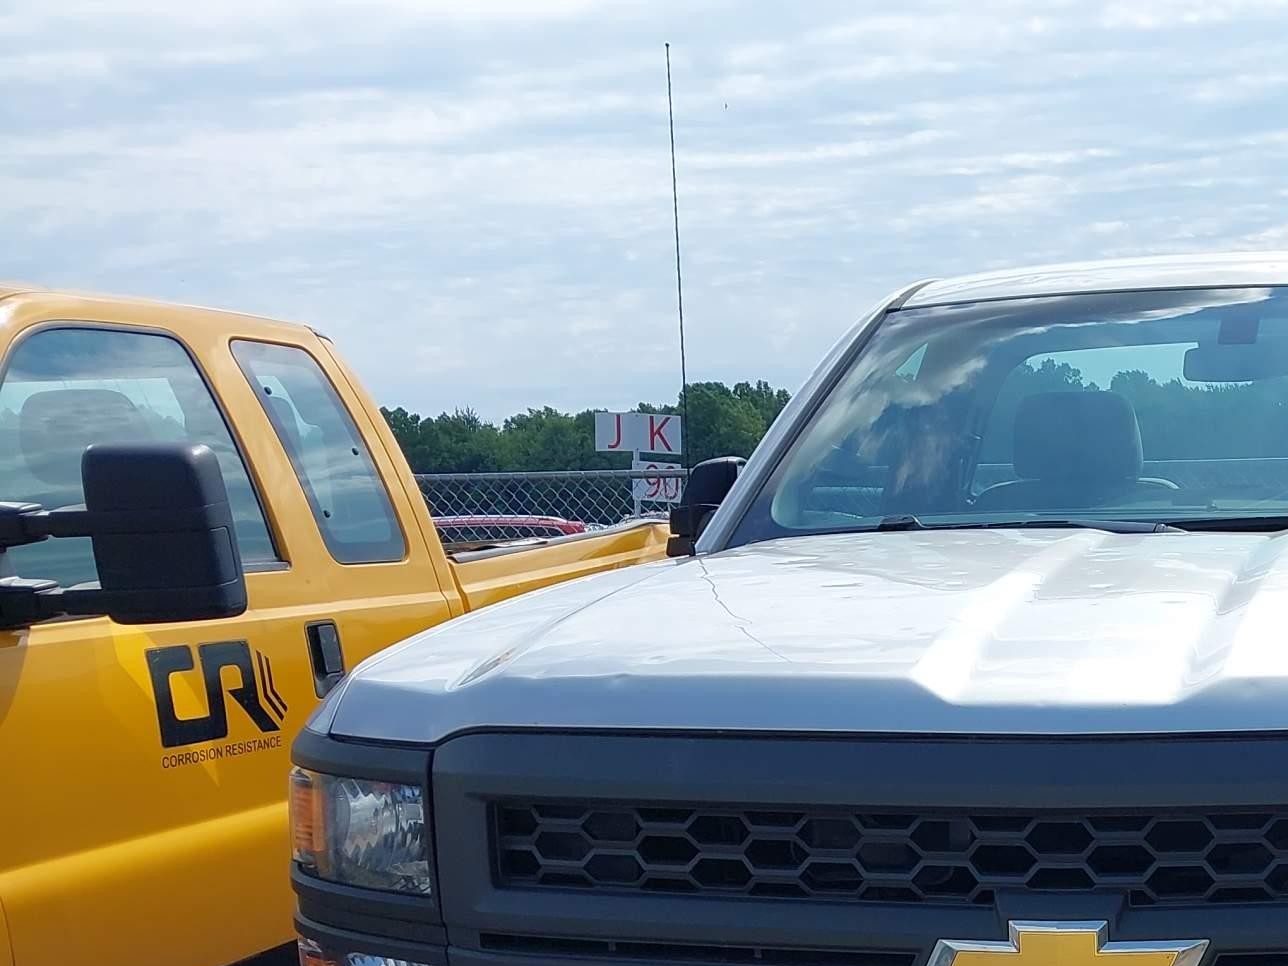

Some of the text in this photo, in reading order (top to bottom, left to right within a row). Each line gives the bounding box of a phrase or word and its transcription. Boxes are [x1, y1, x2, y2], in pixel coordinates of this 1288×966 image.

[607, 414, 673, 452] J K
[146, 641, 280, 748] CR
[162, 736, 281, 769] CORROSION RESISTANCE
